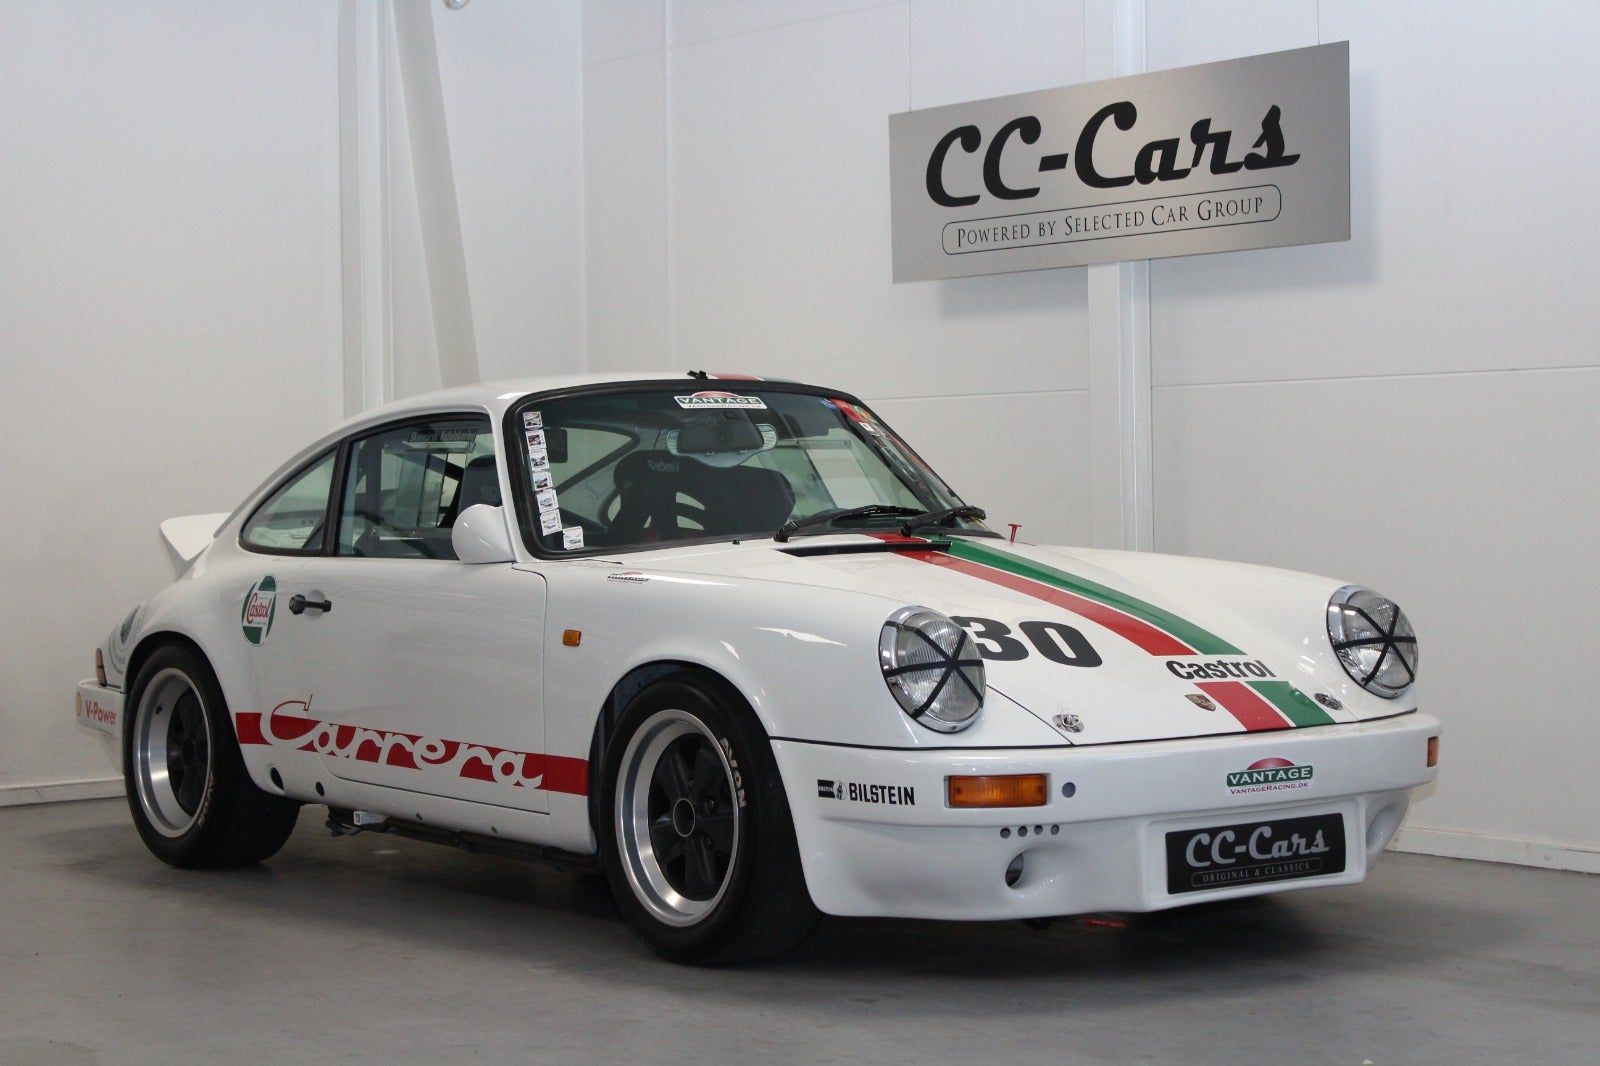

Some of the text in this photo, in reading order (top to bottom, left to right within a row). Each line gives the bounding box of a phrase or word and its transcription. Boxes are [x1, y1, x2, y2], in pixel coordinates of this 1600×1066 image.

[925, 101, 1301, 208] CC-Cars
[957, 197, 1264, 248] POWERED BY SELECTED CAR GROUP
[678, 396, 761, 404] VANTAGE
[246, 592, 272, 625] Castrol
[948, 615, 1103, 668] 30
[1165, 659, 1277, 680] Castrol
[85, 699, 117, 725] V-Power
[259, 693, 544, 790] Carrera
[1228, 767, 1311, 785] VANTAGE
[848, 782, 915, 806] BILSTEIN
[1185, 825, 1330, 868] CC-Cars
[1202, 861, 1311, 884] ORIGINAL & CLASSICS
